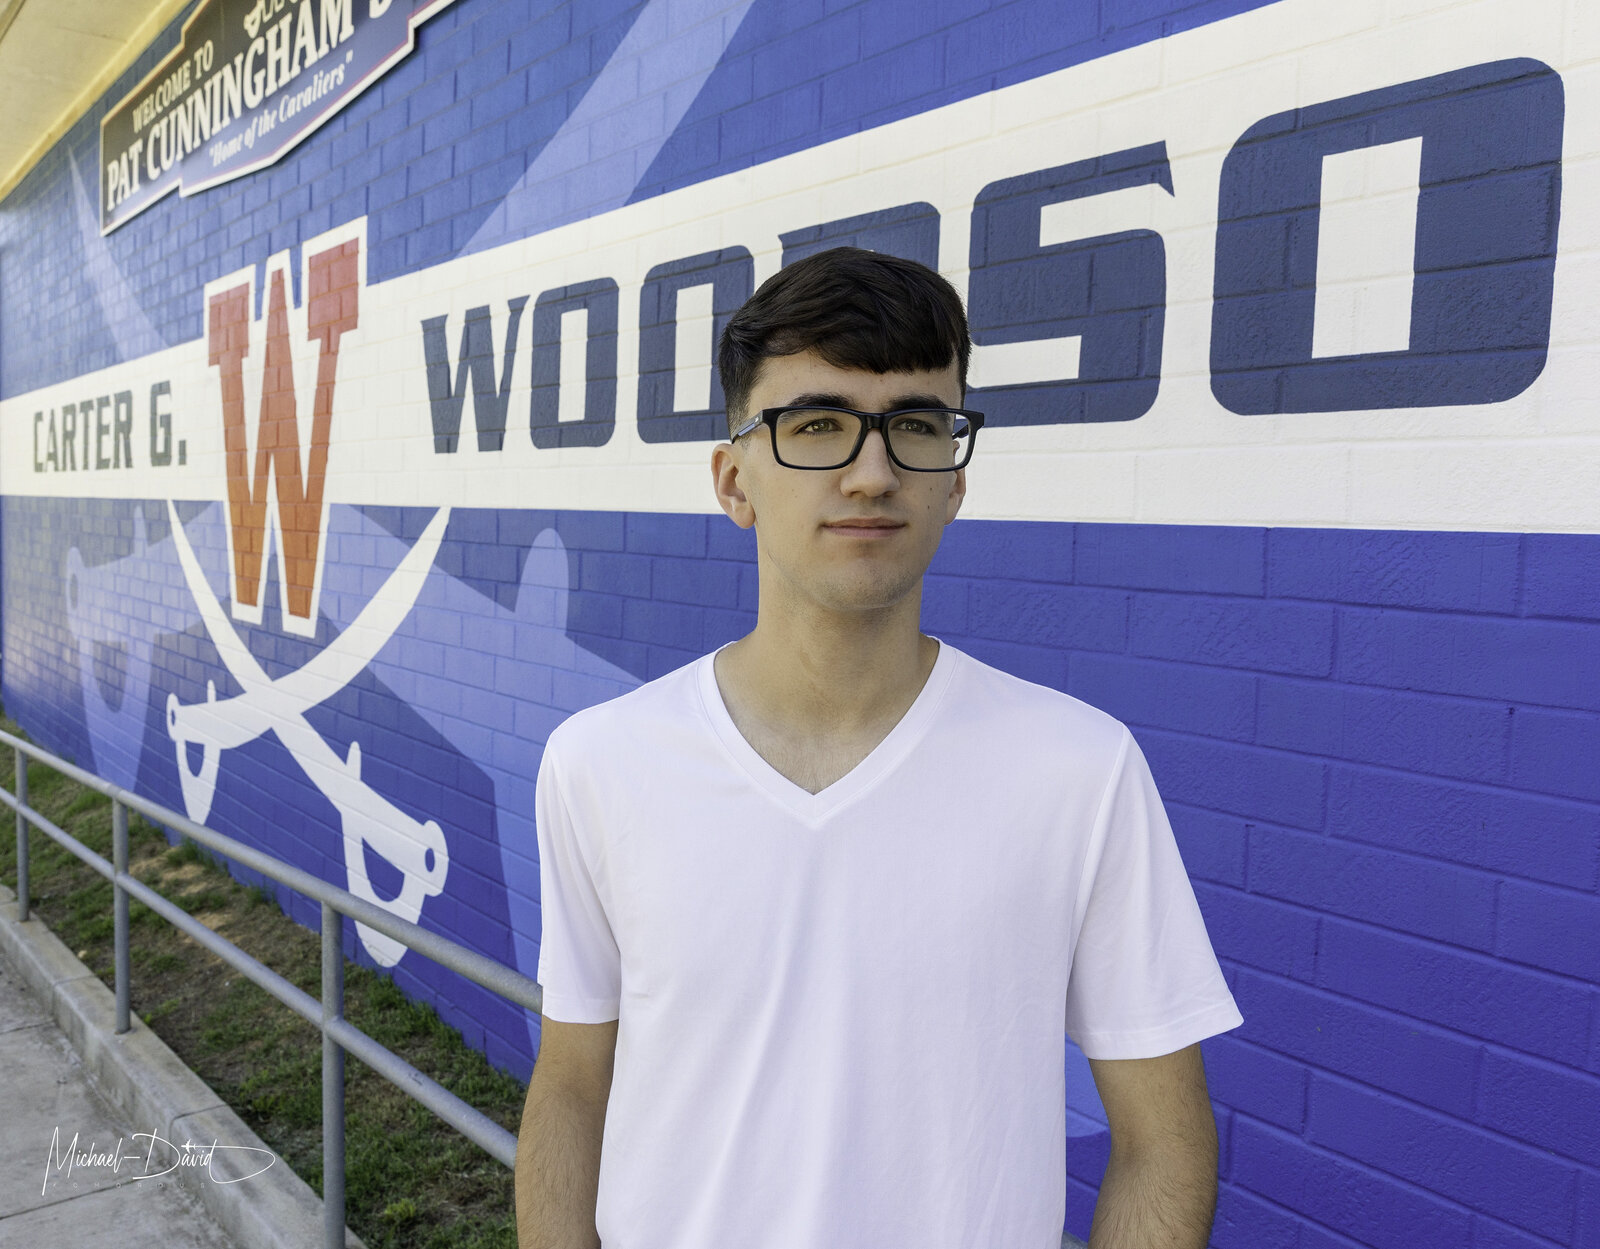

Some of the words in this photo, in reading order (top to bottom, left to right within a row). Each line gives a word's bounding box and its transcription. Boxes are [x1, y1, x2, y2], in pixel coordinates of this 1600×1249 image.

[107, 136, 143, 212] PAT
[146, 0, 354, 182] CUNNINGHAM
[132, 70, 191, 133] WELCOME
[193, 40, 213, 80] TO
[244, 117, 258, 149] of
[258, 109, 277, 138] the
[33, 389, 134, 473] CARTER
[149, 380, 187, 468] G.
[423, 57, 1565, 454] WOOSO
[205, 234, 362, 622] W
